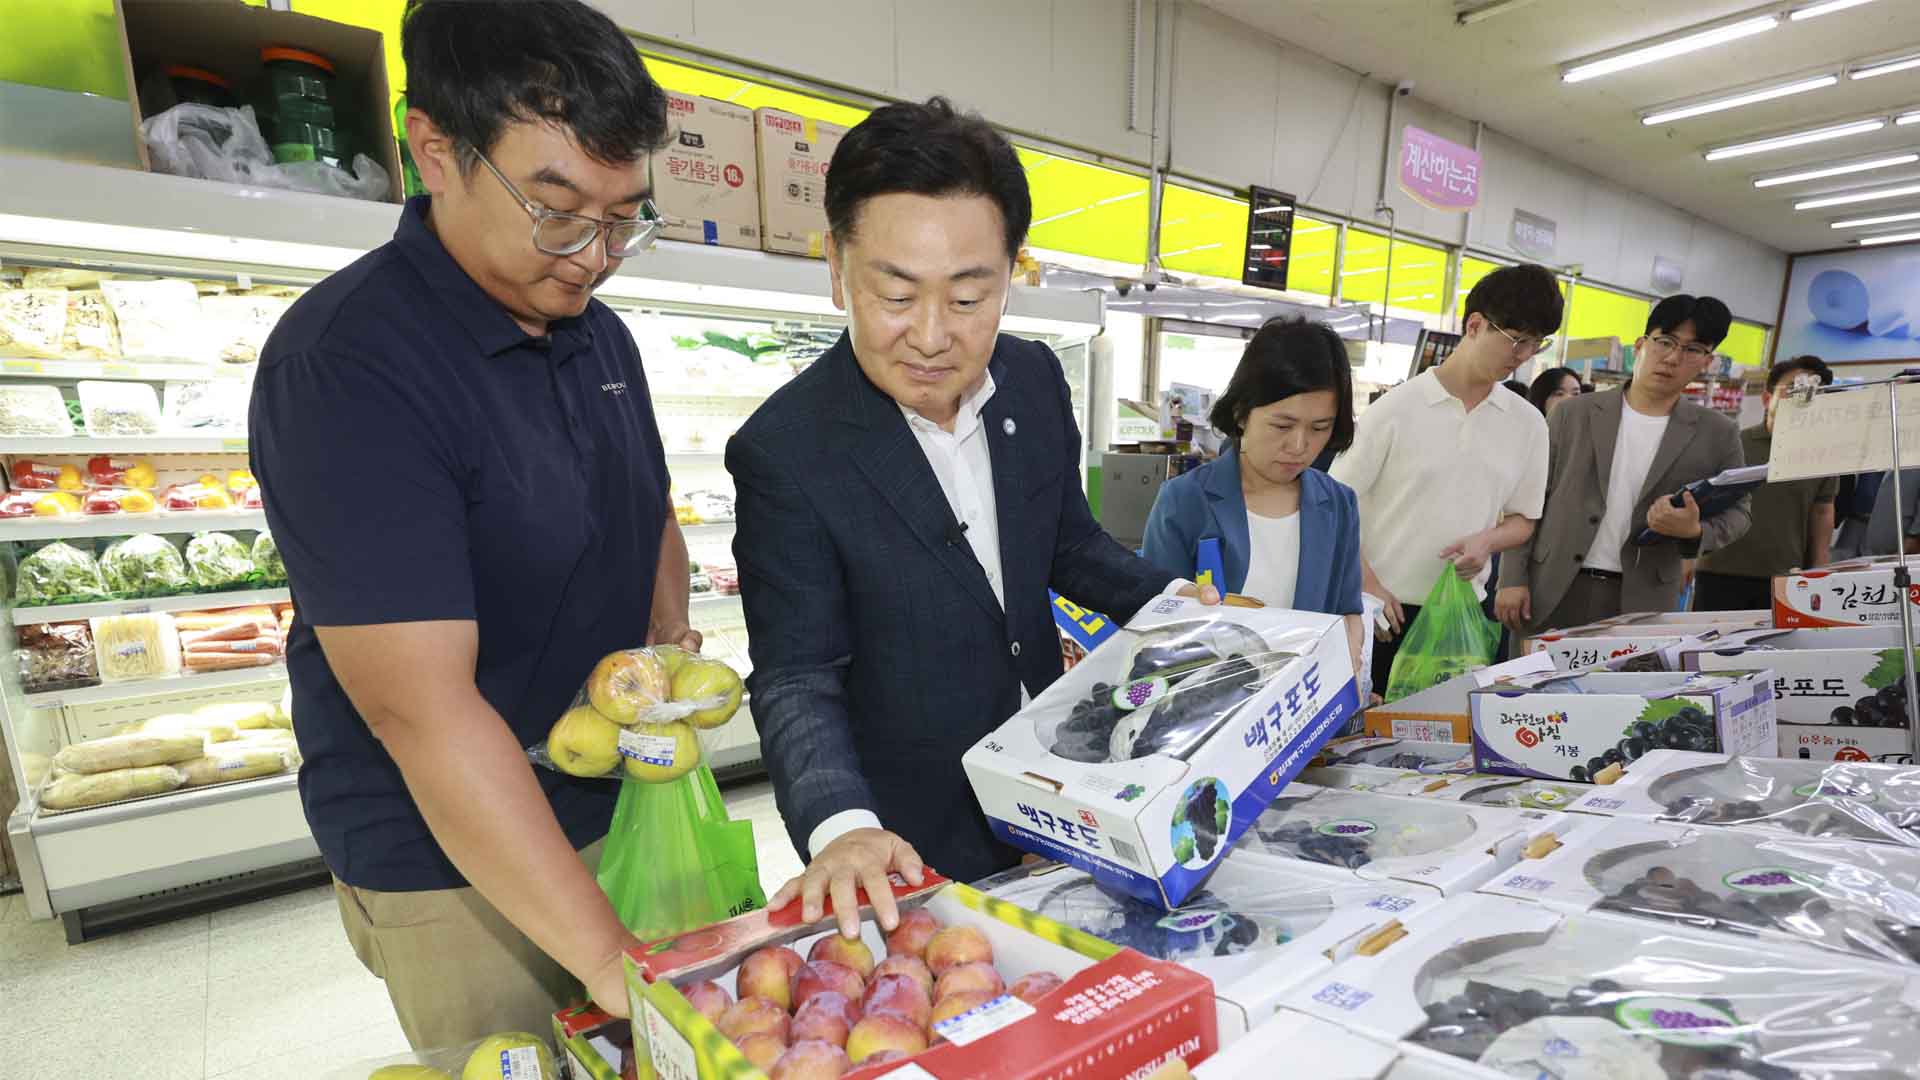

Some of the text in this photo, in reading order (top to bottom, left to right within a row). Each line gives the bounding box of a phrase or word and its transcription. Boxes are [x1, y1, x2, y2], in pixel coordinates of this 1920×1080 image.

[1405, 143, 1477, 196] 계산하는곳
[1244, 661, 1322, 748] 백구포도
[1500, 713, 1546, 727] 과수원의
[1554, 744, 1580, 758] 거봉
[1016, 802, 1101, 850] 백구포도
